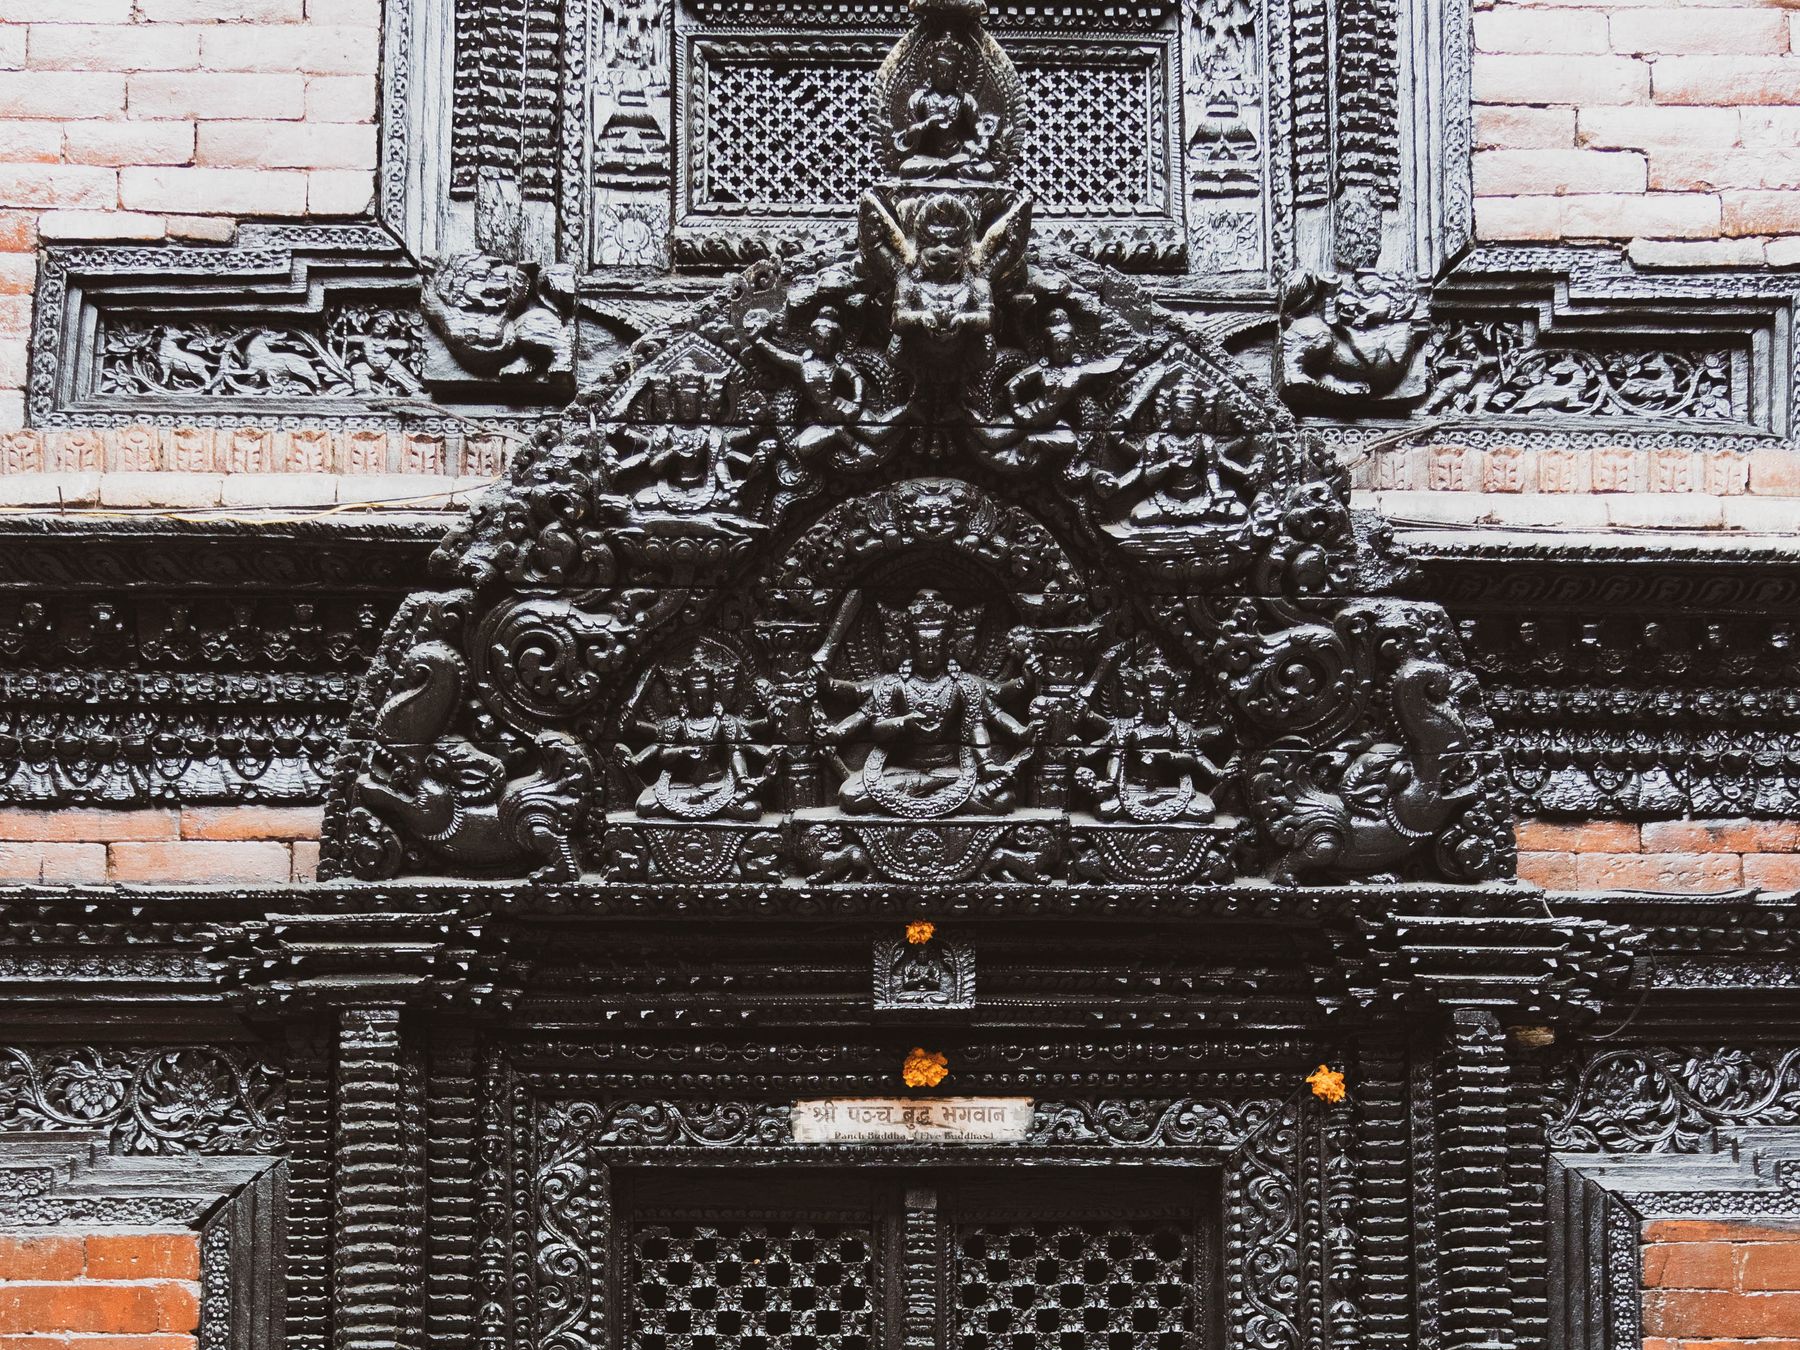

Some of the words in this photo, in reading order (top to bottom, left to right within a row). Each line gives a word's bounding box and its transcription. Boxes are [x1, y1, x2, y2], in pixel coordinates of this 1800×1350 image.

[813, 1098, 838, 1123] श्री
[847, 1106, 893, 1123] पञ्च
[902, 1106, 933, 1130] बुद्ध
[942, 1106, 1008, 1123] भगवान
[834, 1131, 865, 1140] Panch
